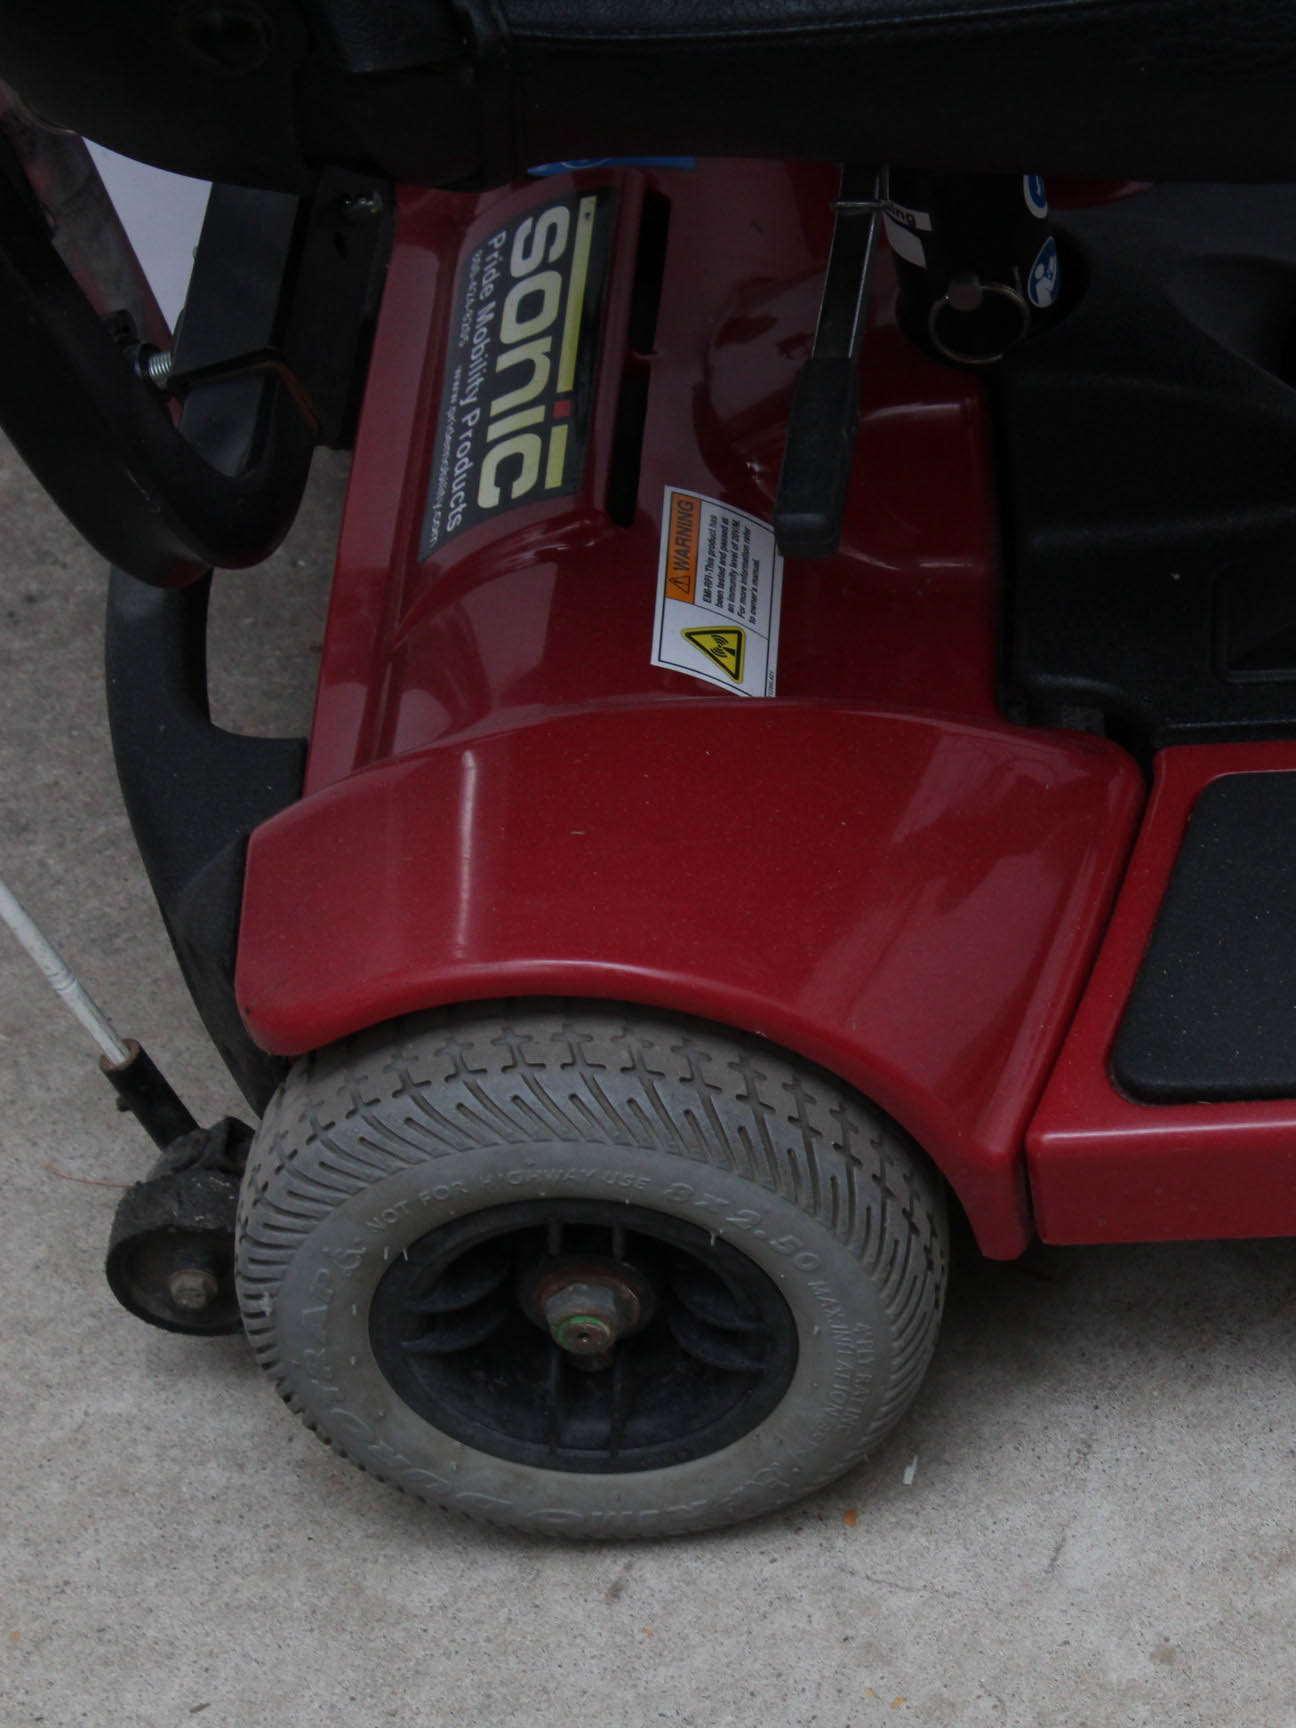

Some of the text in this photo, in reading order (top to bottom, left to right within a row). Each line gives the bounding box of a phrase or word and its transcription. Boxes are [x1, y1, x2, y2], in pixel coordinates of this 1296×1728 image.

[479, 231, 508, 300] Pride
[458, 300, 497, 407] Mobility
[477, 205, 571, 509] sonic
[446, 408, 481, 533] Products
[673, 499, 695, 571] WARNING
[709, 516, 717, 530] has
[708, 529, 717, 557] product
[720, 525, 729, 553] passed
[719, 552, 727, 567] and
[730, 550, 739, 570] level
[739, 544, 750, 586] information
[717, 567, 727, 589] tested
[727, 569, 738, 602] immunity
[715, 589, 723, 608] been
[739, 585, 747, 605] more
[750, 587, 759, 615] owner's
[737, 604, 746, 619] For
[365, 1199, 409, 1234] NOT
[417, 1179, 469, 1206] FOR
[602, 1170, 653, 1191] USE
